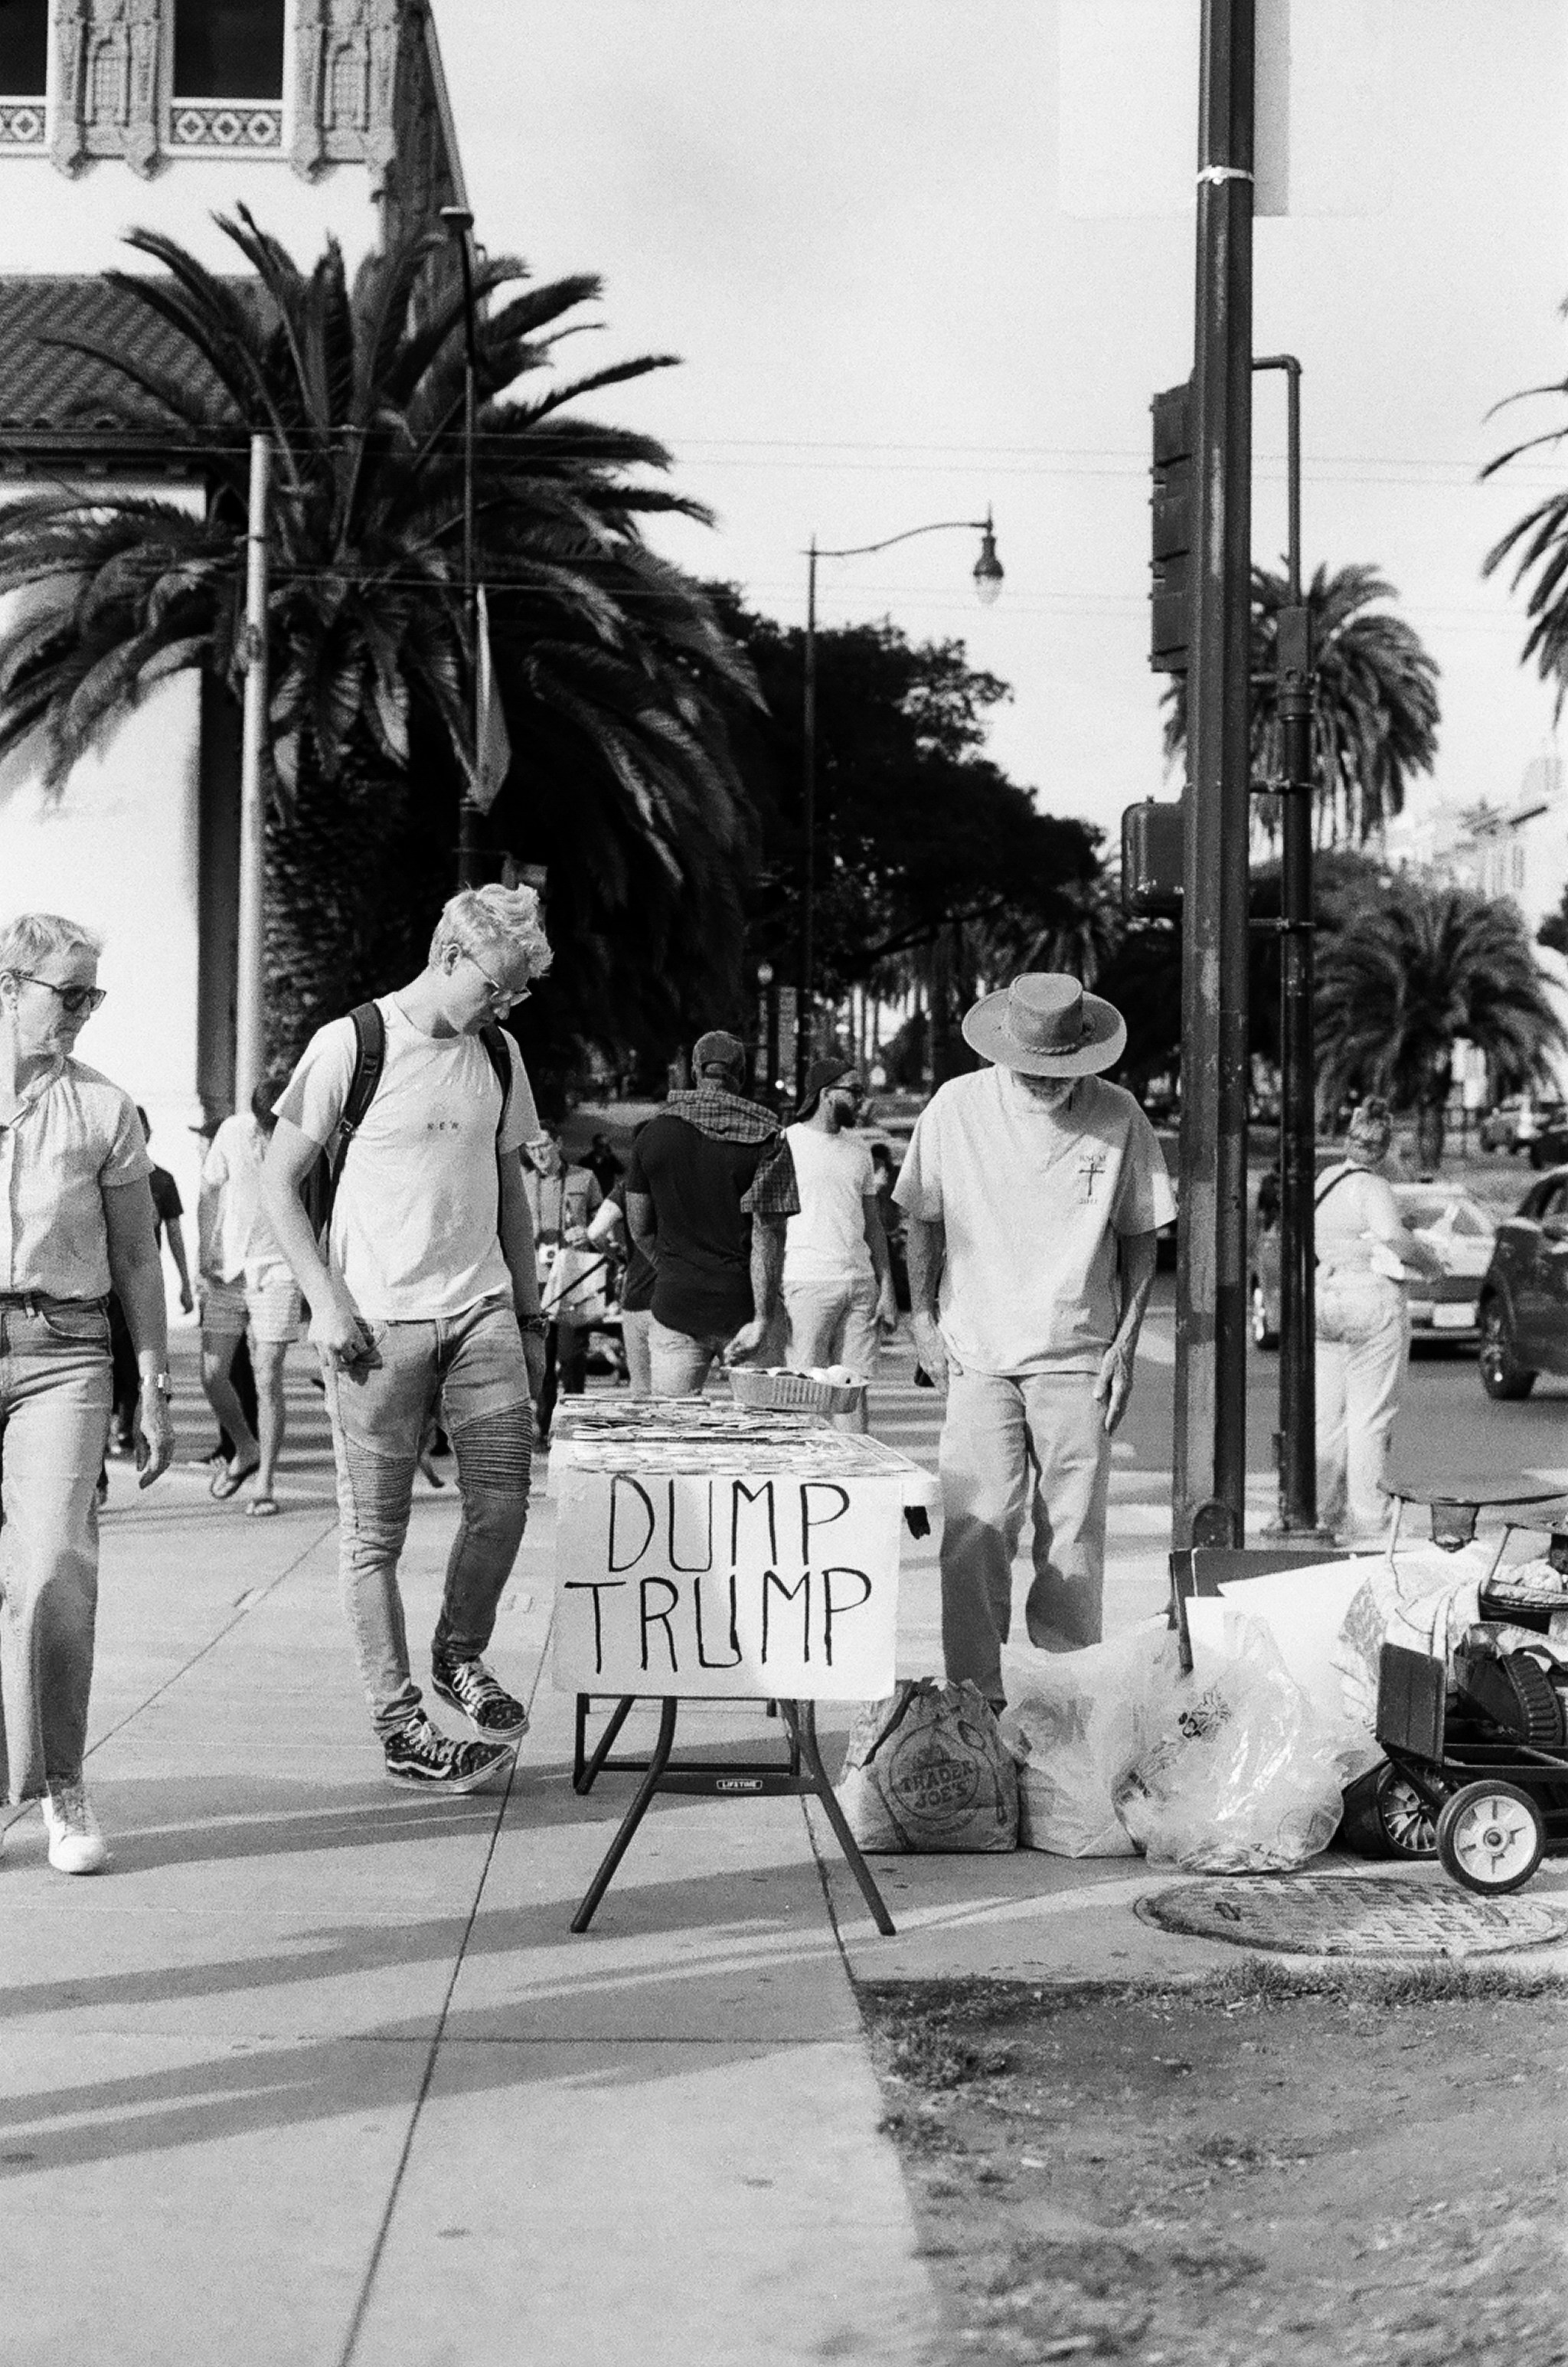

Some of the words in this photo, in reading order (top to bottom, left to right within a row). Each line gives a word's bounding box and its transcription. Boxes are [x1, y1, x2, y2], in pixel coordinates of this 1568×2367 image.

[609, 1475, 850, 1572] DUMP
[564, 1568, 872, 1675] TRUMP
[900, 1760, 974, 1793] TRADER
[915, 1780, 968, 1809] JOE'S
